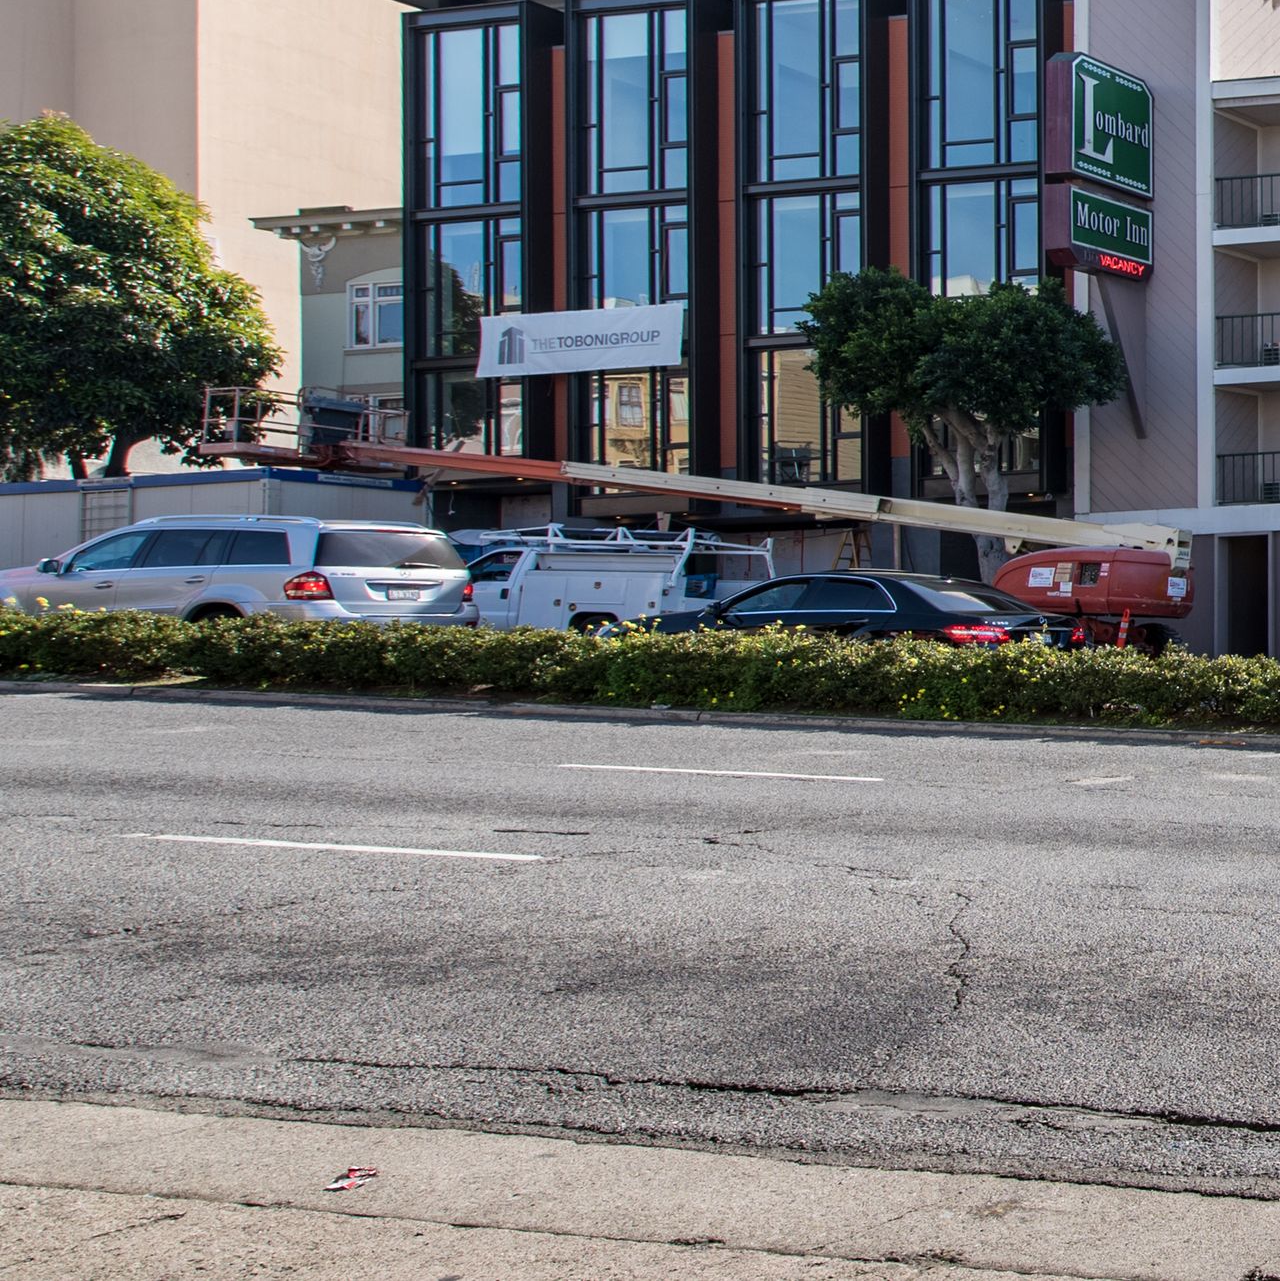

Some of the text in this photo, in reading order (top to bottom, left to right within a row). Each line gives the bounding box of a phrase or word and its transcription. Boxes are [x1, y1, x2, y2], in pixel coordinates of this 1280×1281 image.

[1076, 71, 1149, 165] Lombard
[1076, 200, 1148, 246] Motor Inn
[1099, 253, 1145, 276] VACANCY
